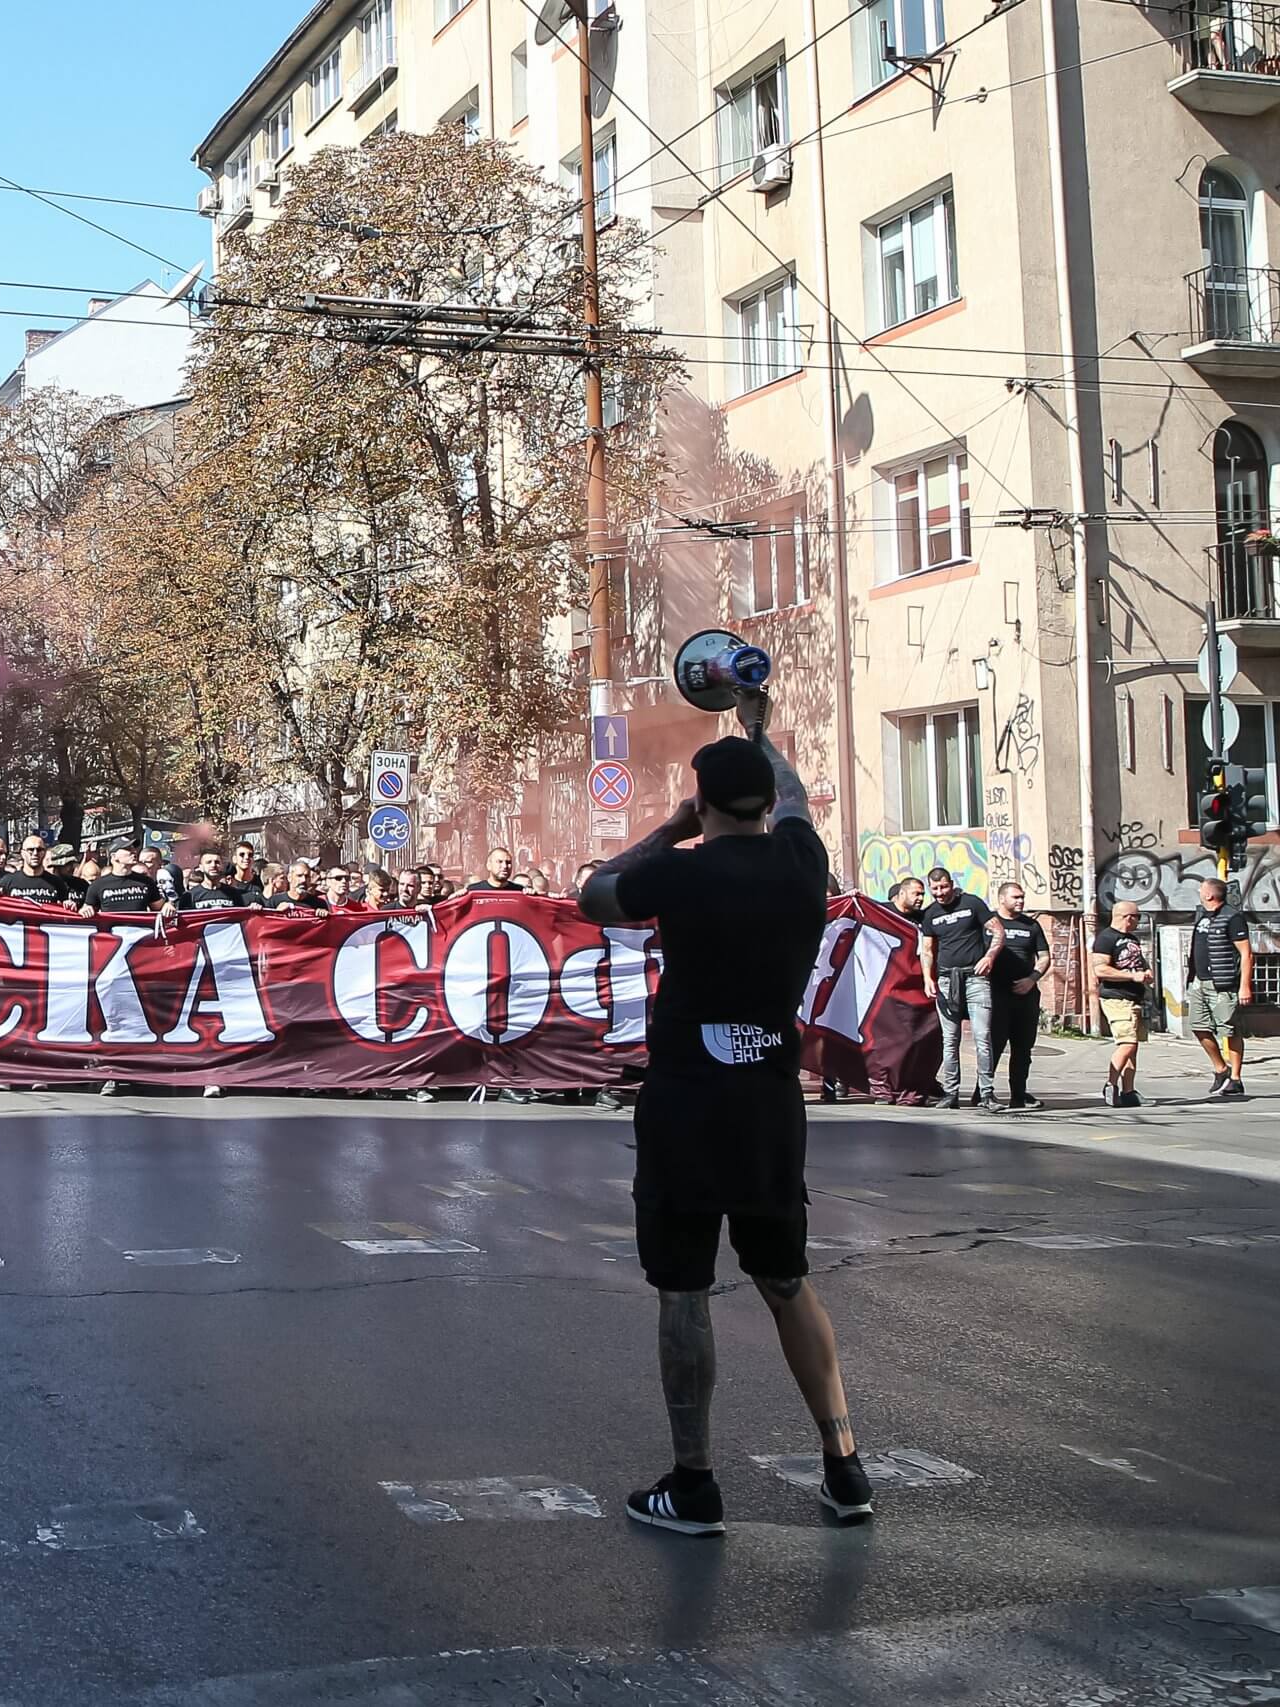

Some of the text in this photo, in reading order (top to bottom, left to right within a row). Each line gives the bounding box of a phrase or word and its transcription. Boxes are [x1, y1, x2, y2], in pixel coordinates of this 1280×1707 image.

[376, 756, 406, 769] ЗОНА
[731, 1023, 763, 1036] SIDE
[732, 1032, 783, 1049] NORTH
[734, 1048, 764, 1063] THE
